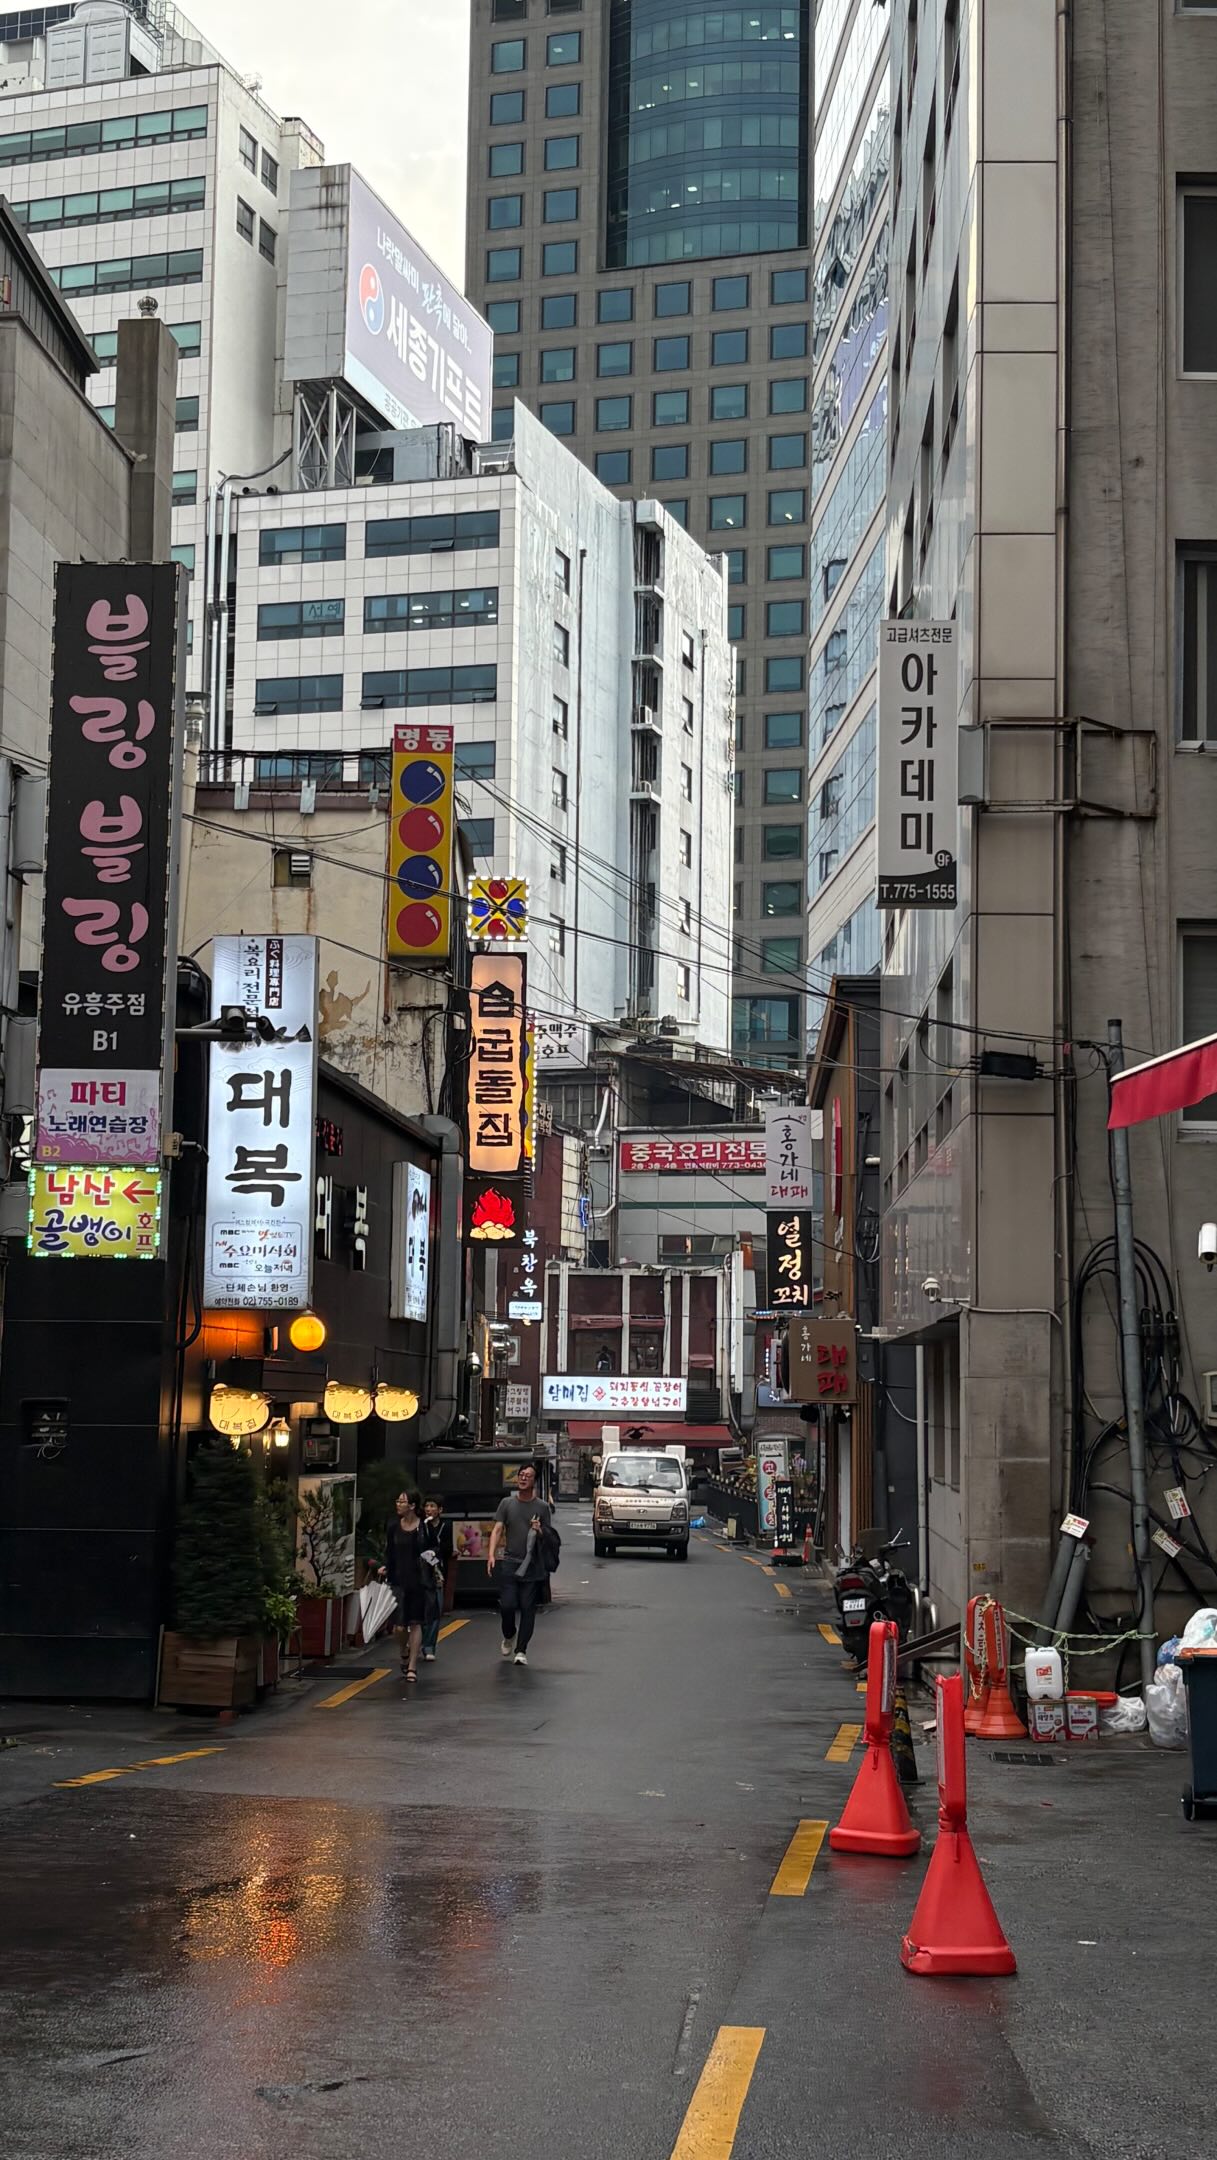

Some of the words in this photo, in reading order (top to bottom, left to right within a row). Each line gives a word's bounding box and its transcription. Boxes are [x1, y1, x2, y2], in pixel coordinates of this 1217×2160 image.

[386, 295, 482, 441] 세종기프트
[900, 652, 938, 855] 아카데미
[936, 852, 950, 869] 9F
[880, 883, 956, 900] T.775-1555
[61, 992, 146, 1016] 유흥주점
[92, 1030, 119, 1051] B1
[70, 1080, 127, 1106] 파티
[48, 1115, 149, 1135] 노래연습장
[225, 1068, 303, 1208] 대복
[41, 1145, 61, 1157] B2
[48, 1173, 116, 1206] 남산
[769, 1184, 809, 1199] 대패
[34, 1207, 132, 1252] 골뱅이
[135, 1211, 154, 1251] 호프
[223, 1243, 297, 1258] 수요미식회
[519, 1229, 539, 1298] 북창옥
